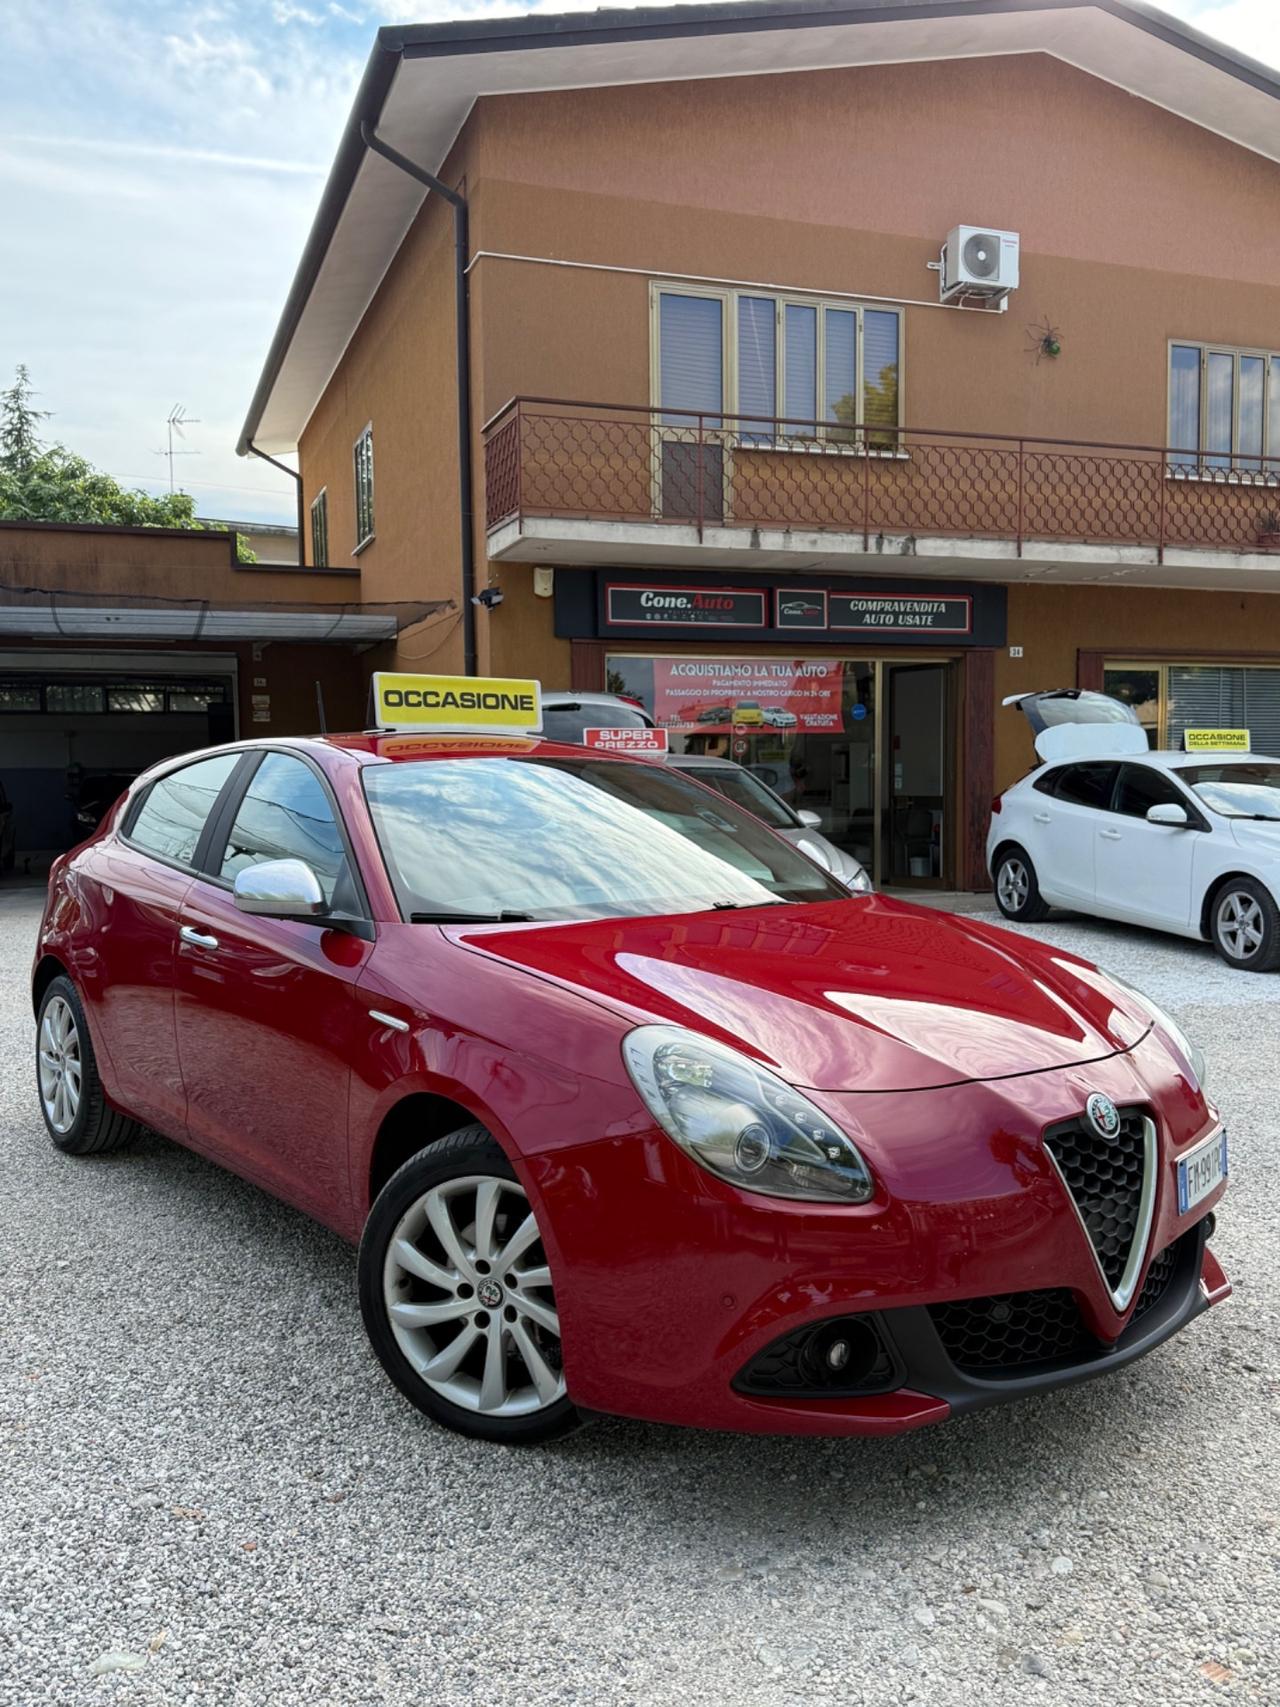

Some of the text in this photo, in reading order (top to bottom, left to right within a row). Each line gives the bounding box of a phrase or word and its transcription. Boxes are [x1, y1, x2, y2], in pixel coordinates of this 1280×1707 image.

[640, 592, 734, 610] Cone.Auto
[850, 600, 946, 613] COMPRAVENDITA
[862, 613, 933, 626] AUTO USATE
[670, 664, 827, 678] ACQUISTIAMO LA TUA AUTO
[665, 688, 702, 697] PASSAGGIO
[703, 689, 710, 697] DI
[383, 690, 534, 711] OCCASIONE
[599, 730, 654, 740] SUPER
[594, 740, 659, 749] PREZZO
